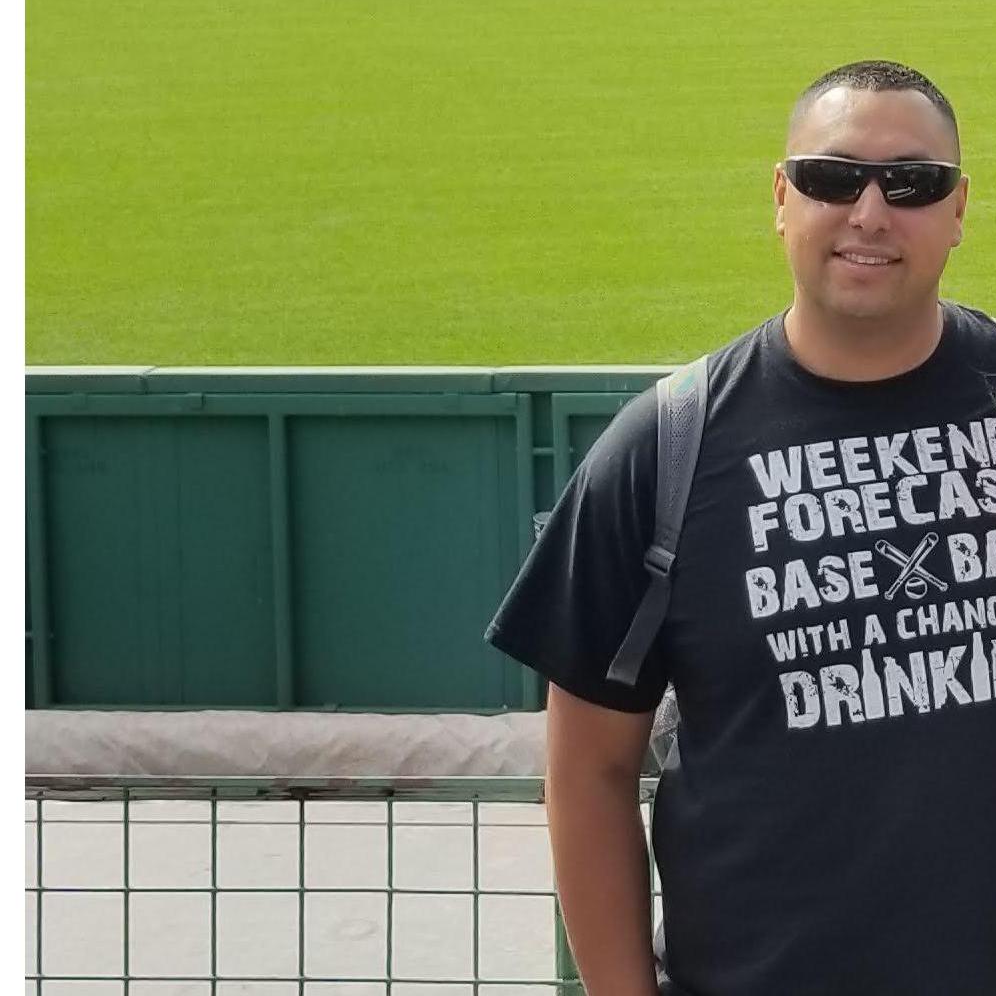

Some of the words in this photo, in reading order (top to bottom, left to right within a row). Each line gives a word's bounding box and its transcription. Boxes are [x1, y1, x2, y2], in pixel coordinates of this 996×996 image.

[745, 550, 880, 618] BASE
[766, 619, 851, 662] WITH
[863, 614, 887, 647] A
